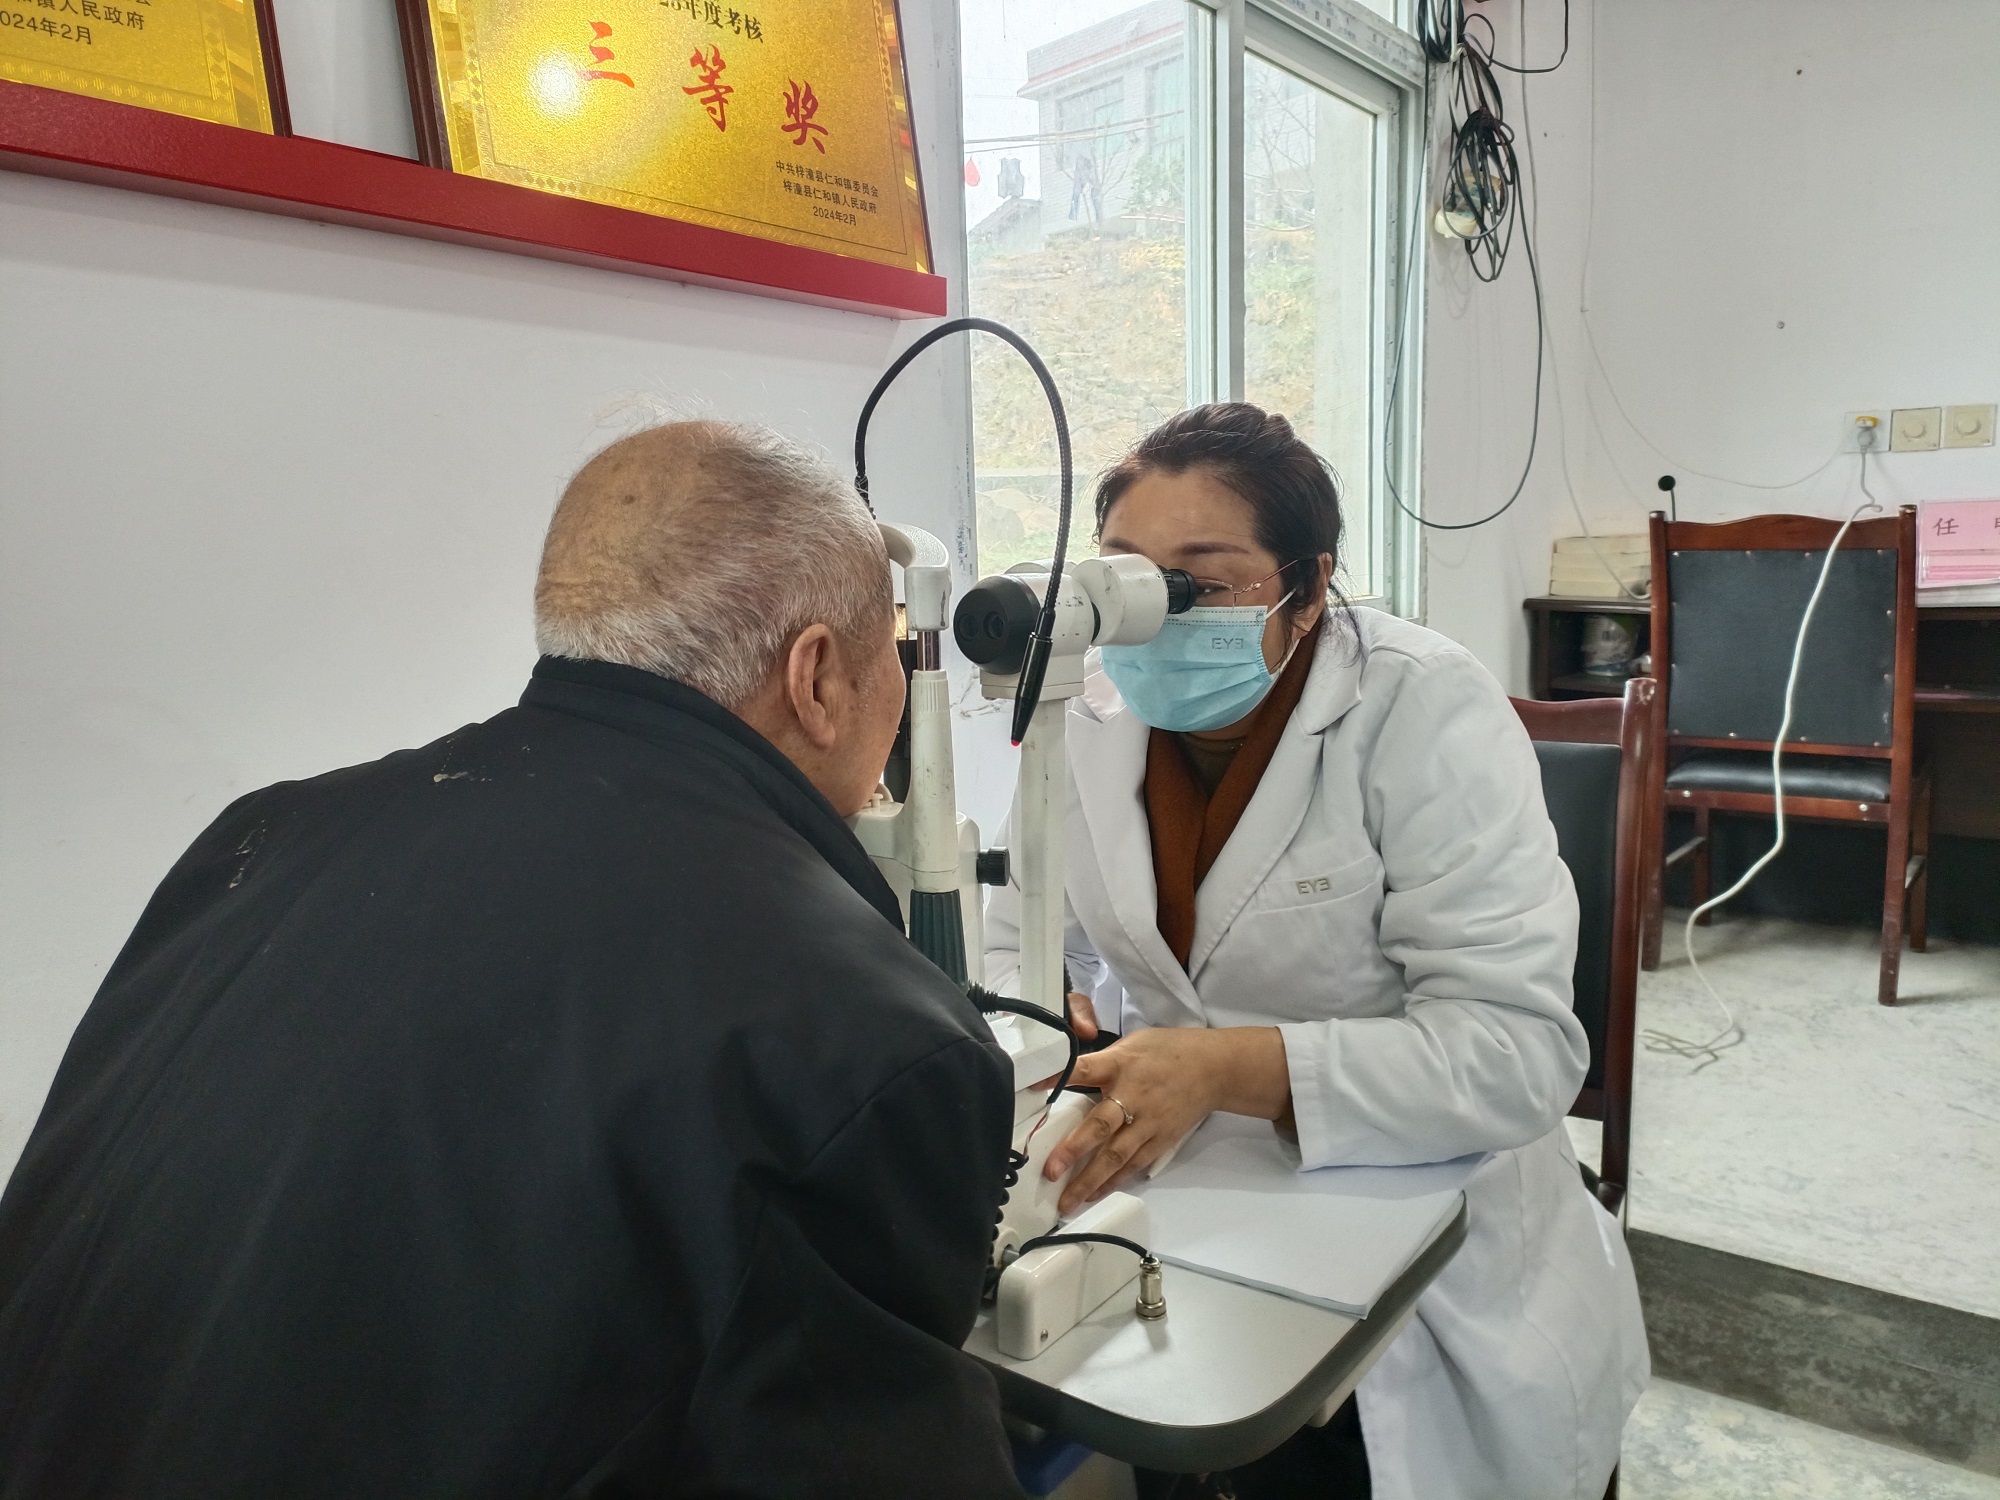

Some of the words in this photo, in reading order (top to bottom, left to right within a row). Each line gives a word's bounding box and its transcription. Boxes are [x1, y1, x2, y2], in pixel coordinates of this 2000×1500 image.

[577, 19, 829, 155] 三等奖
[775, 160, 879, 198] 中共梓潼县仁和镇委员会
[783, 179, 877, 214] 梓潼县仁和镇人民政府
[812, 205, 857, 227] 2024年2月
[1211, 637, 1244, 650] EYE
[1295, 876, 1331, 895] EYE
